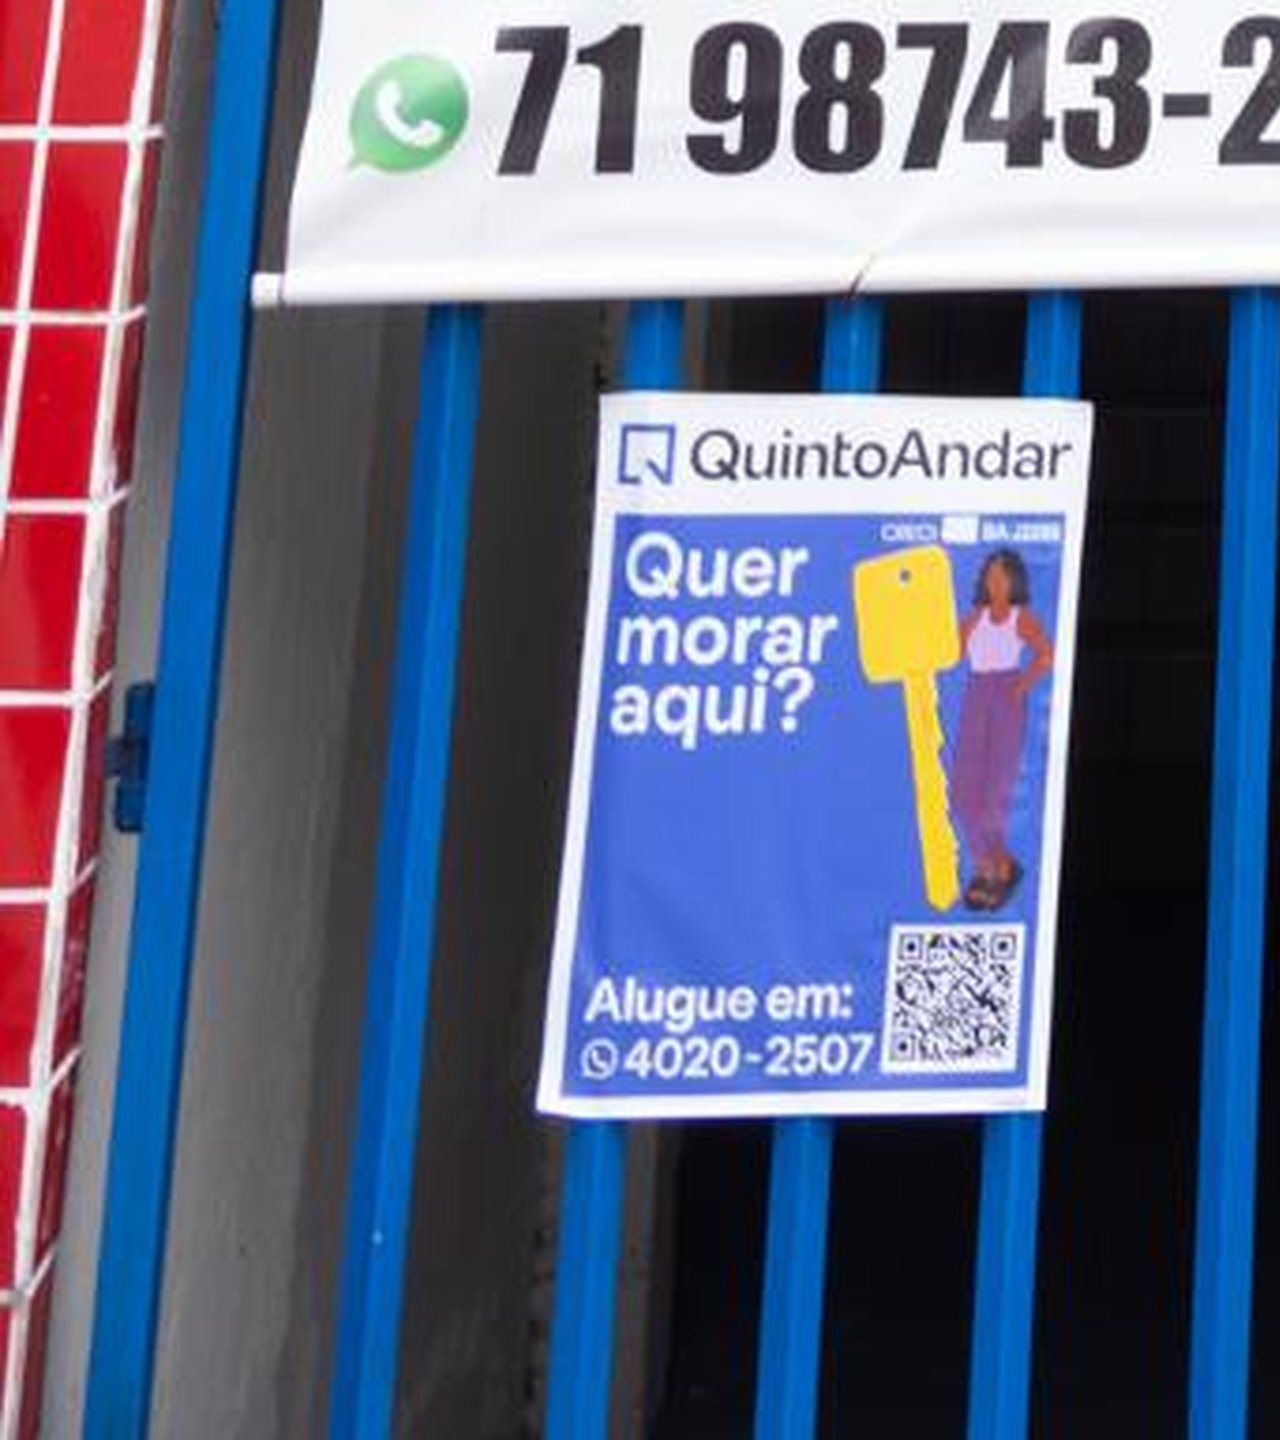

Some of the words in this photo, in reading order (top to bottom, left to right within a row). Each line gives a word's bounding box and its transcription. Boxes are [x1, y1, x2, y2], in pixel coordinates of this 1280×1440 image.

[493, 22, 646, 177] 71
[689, 428, 1073, 483] QuintoAndar
[624, 531, 811, 601] Quer
[615, 613, 840, 666] morar
[609, 667, 816, 751] aqui?
[583, 976, 758, 1033] Alugue
[765, 983, 855, 1022] em:
[622, 1032, 876, 1081] 4020-2507
